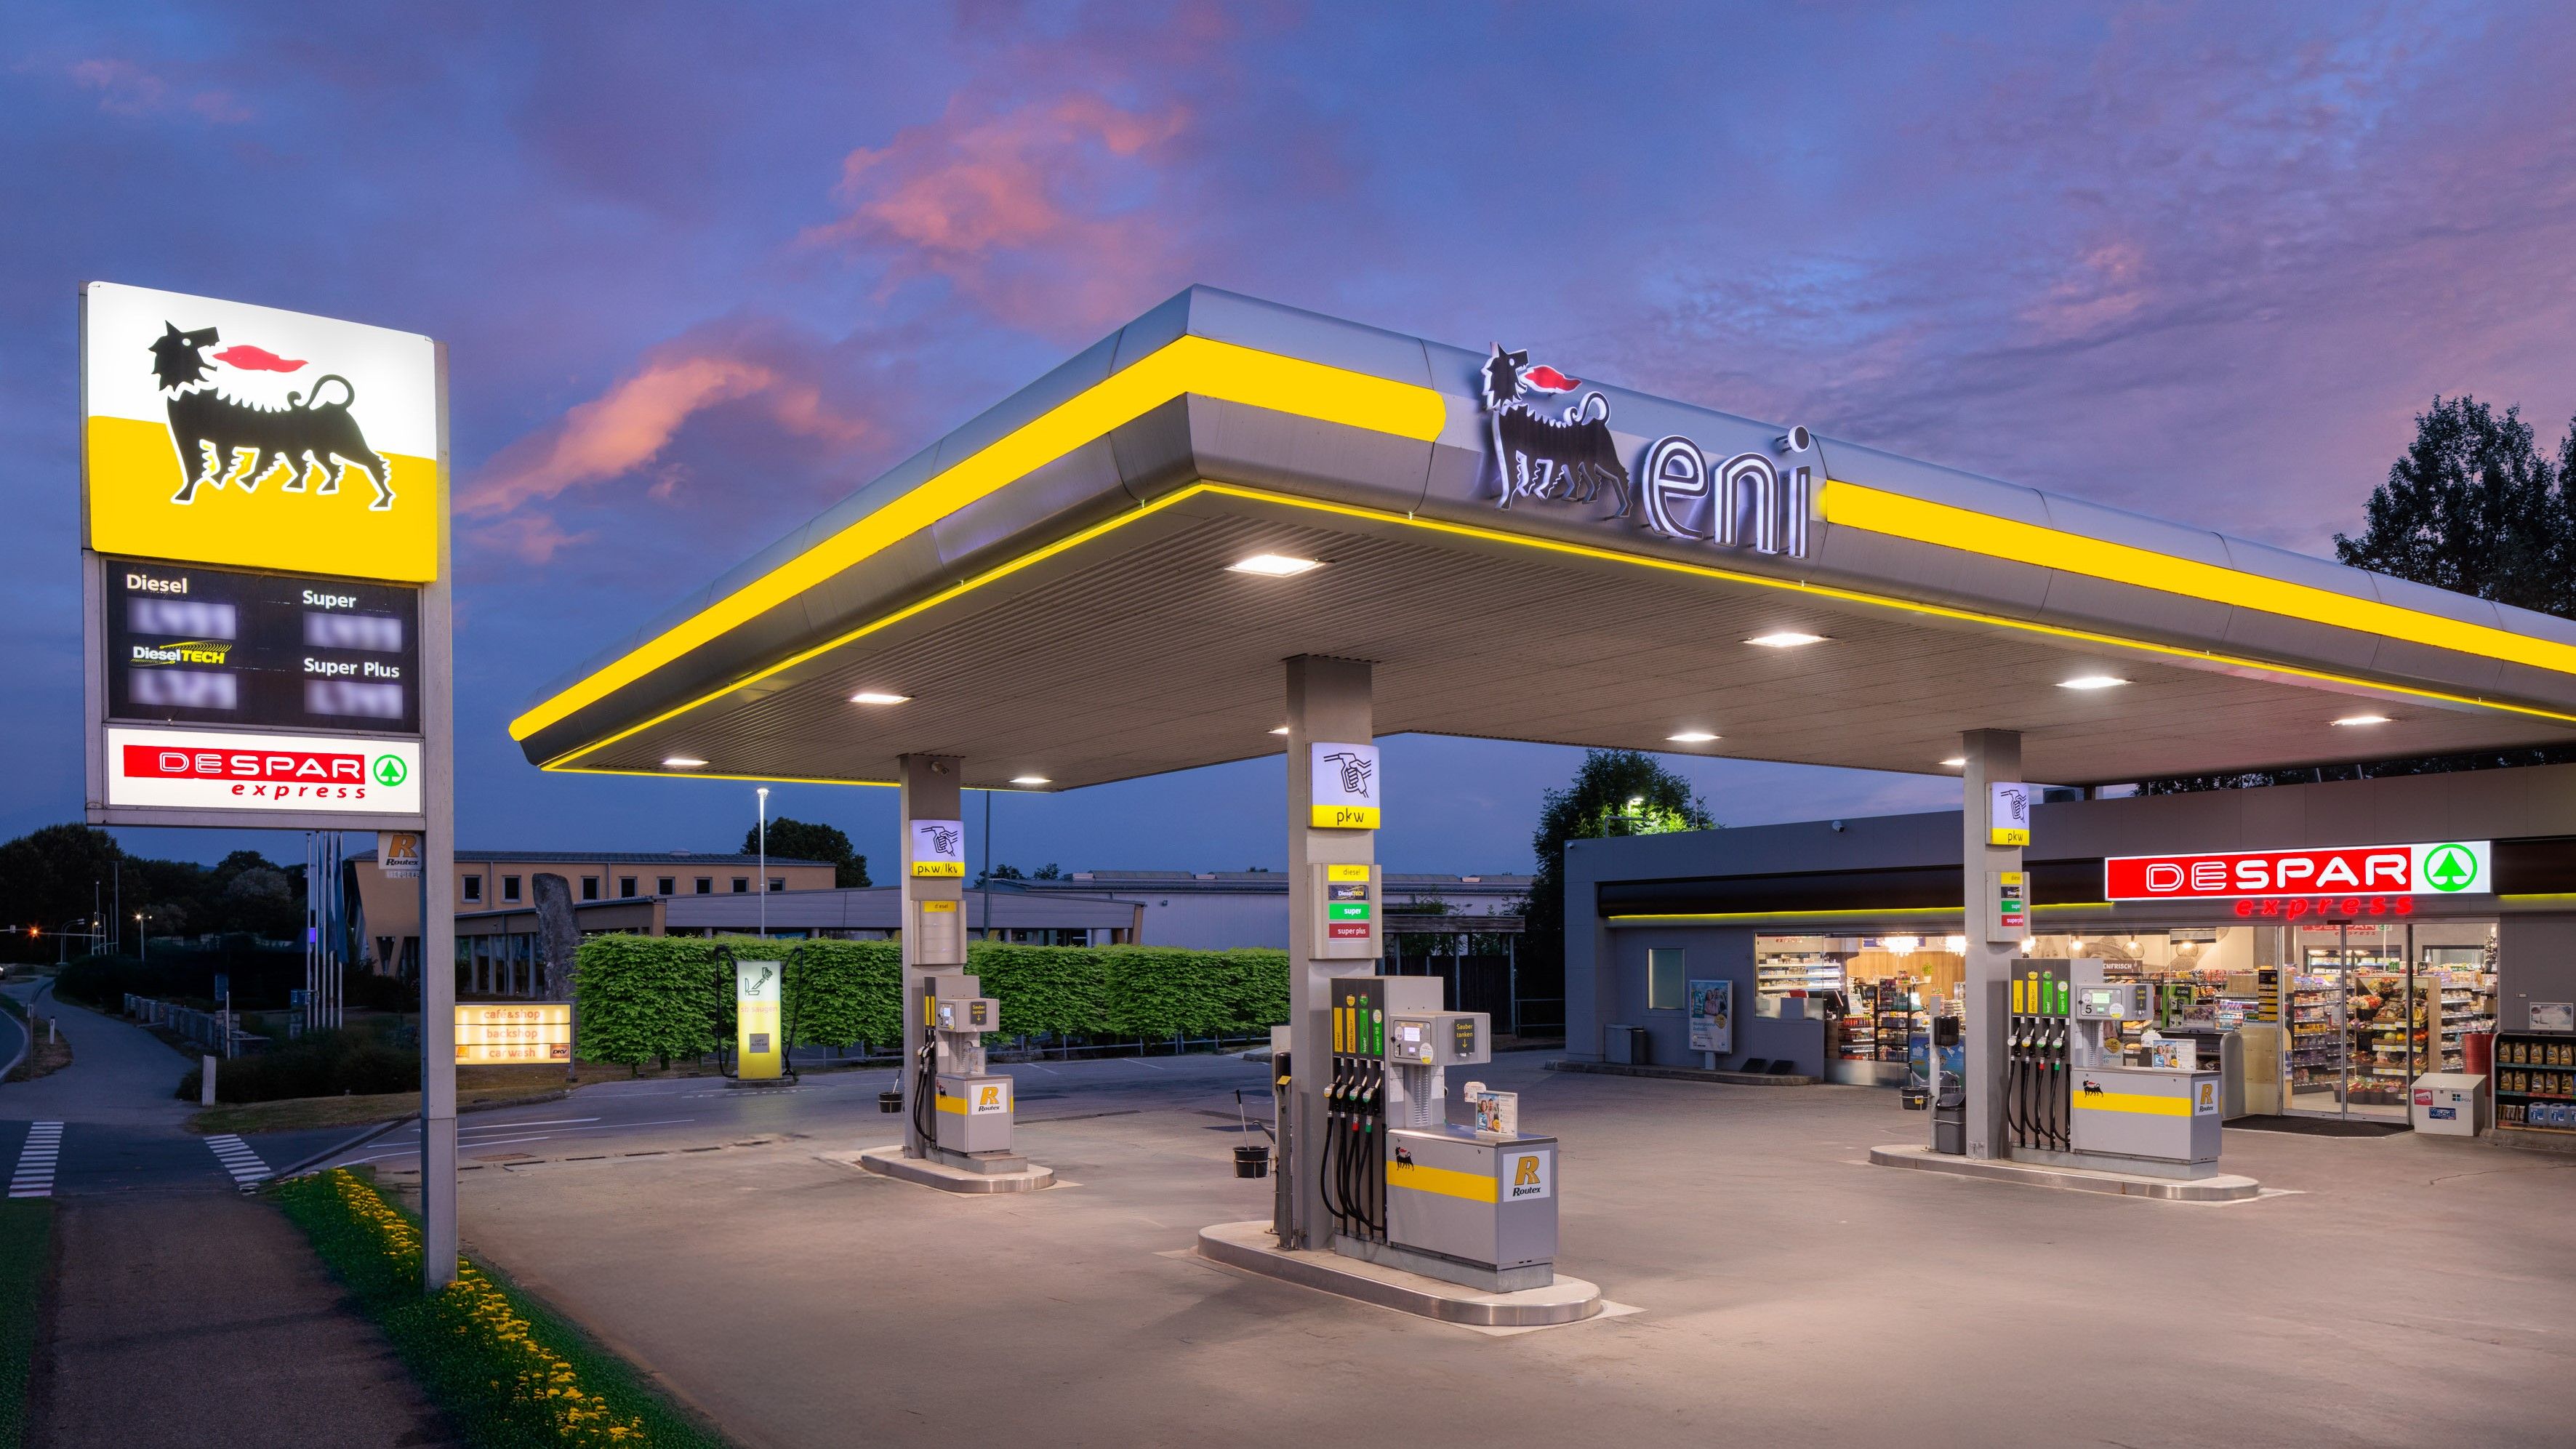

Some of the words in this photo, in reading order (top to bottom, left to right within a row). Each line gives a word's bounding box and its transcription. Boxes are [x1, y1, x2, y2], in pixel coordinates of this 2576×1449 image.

[1642, 425, 1810, 559] eni
[127, 574, 188, 593] Diesel
[302, 590, 356, 609] Super
[133, 646, 225, 665] DieselTECH
[304, 657, 358, 676] Super
[364, 661, 400, 678] Plus
[159, 752, 361, 779] DESPAR
[231, 782, 366, 800] express
[1336, 808, 1364, 826] pkw
[2007, 830, 2023, 843] pkw
[2146, 854, 2407, 893] DESPAR
[2235, 895, 2413, 920] express
[2085, 1005, 2092, 1014] 5
[487, 1029, 537, 1039] backshop
[508, 1048, 535, 1057] wash
[1397, 1043, 1401, 1056] 1
[1513, 1187, 1541, 1197] Routex
